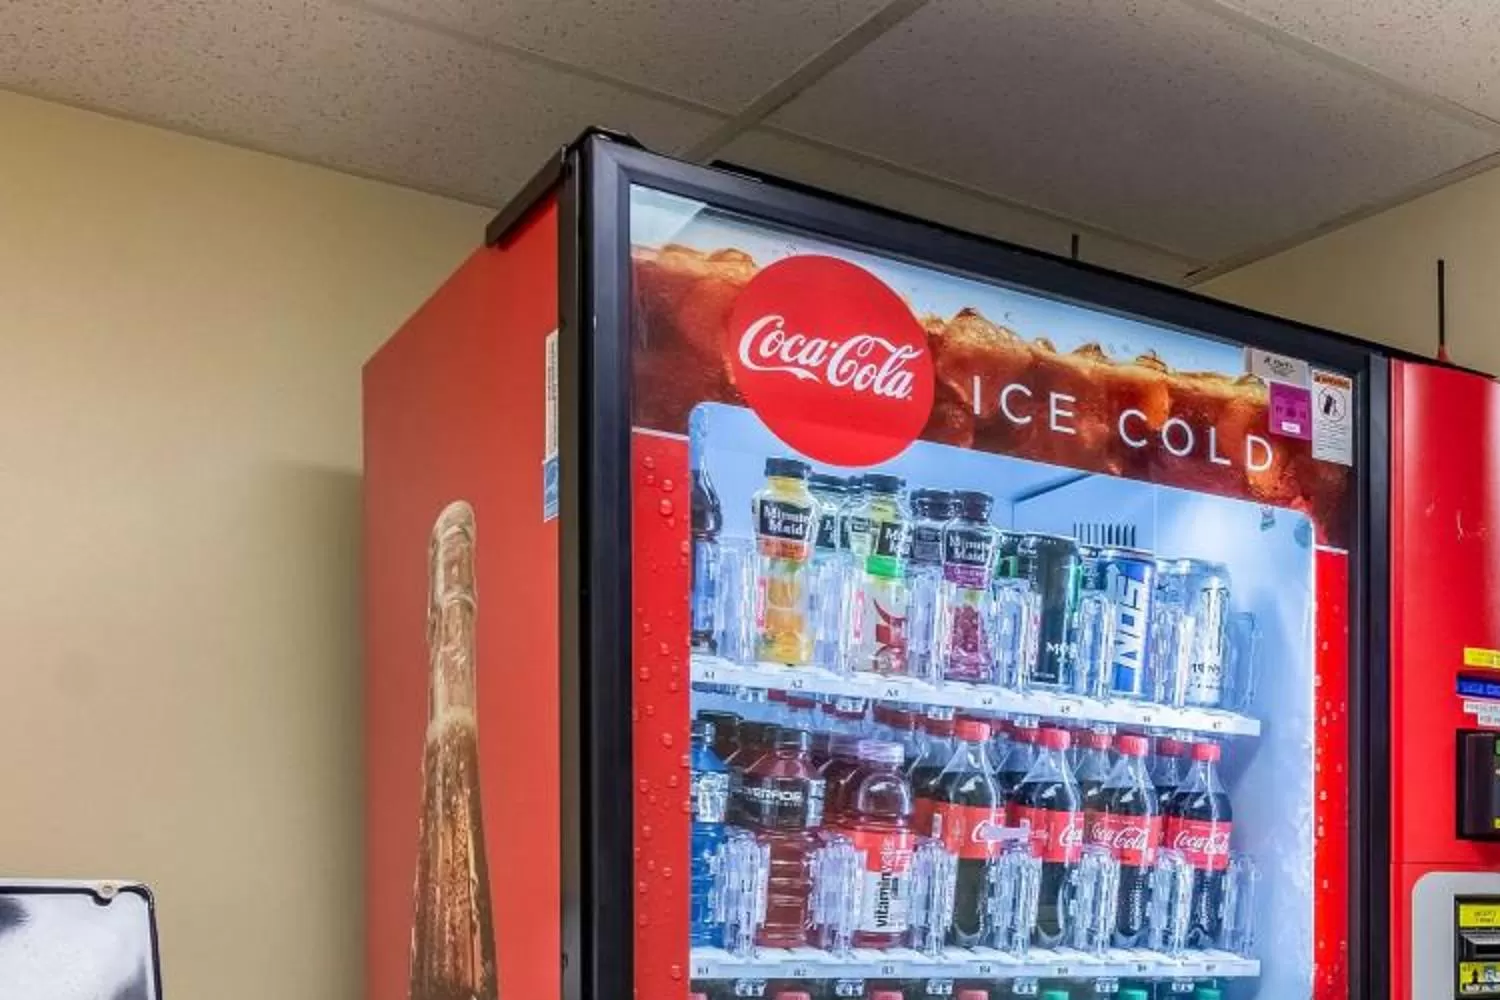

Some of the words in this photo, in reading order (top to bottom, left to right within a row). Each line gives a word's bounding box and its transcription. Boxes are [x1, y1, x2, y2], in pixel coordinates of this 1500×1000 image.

[972, 375, 1076, 435] ICE
[1119, 409, 1273, 472] COLD
[1112, 575, 1146, 668] NOS
